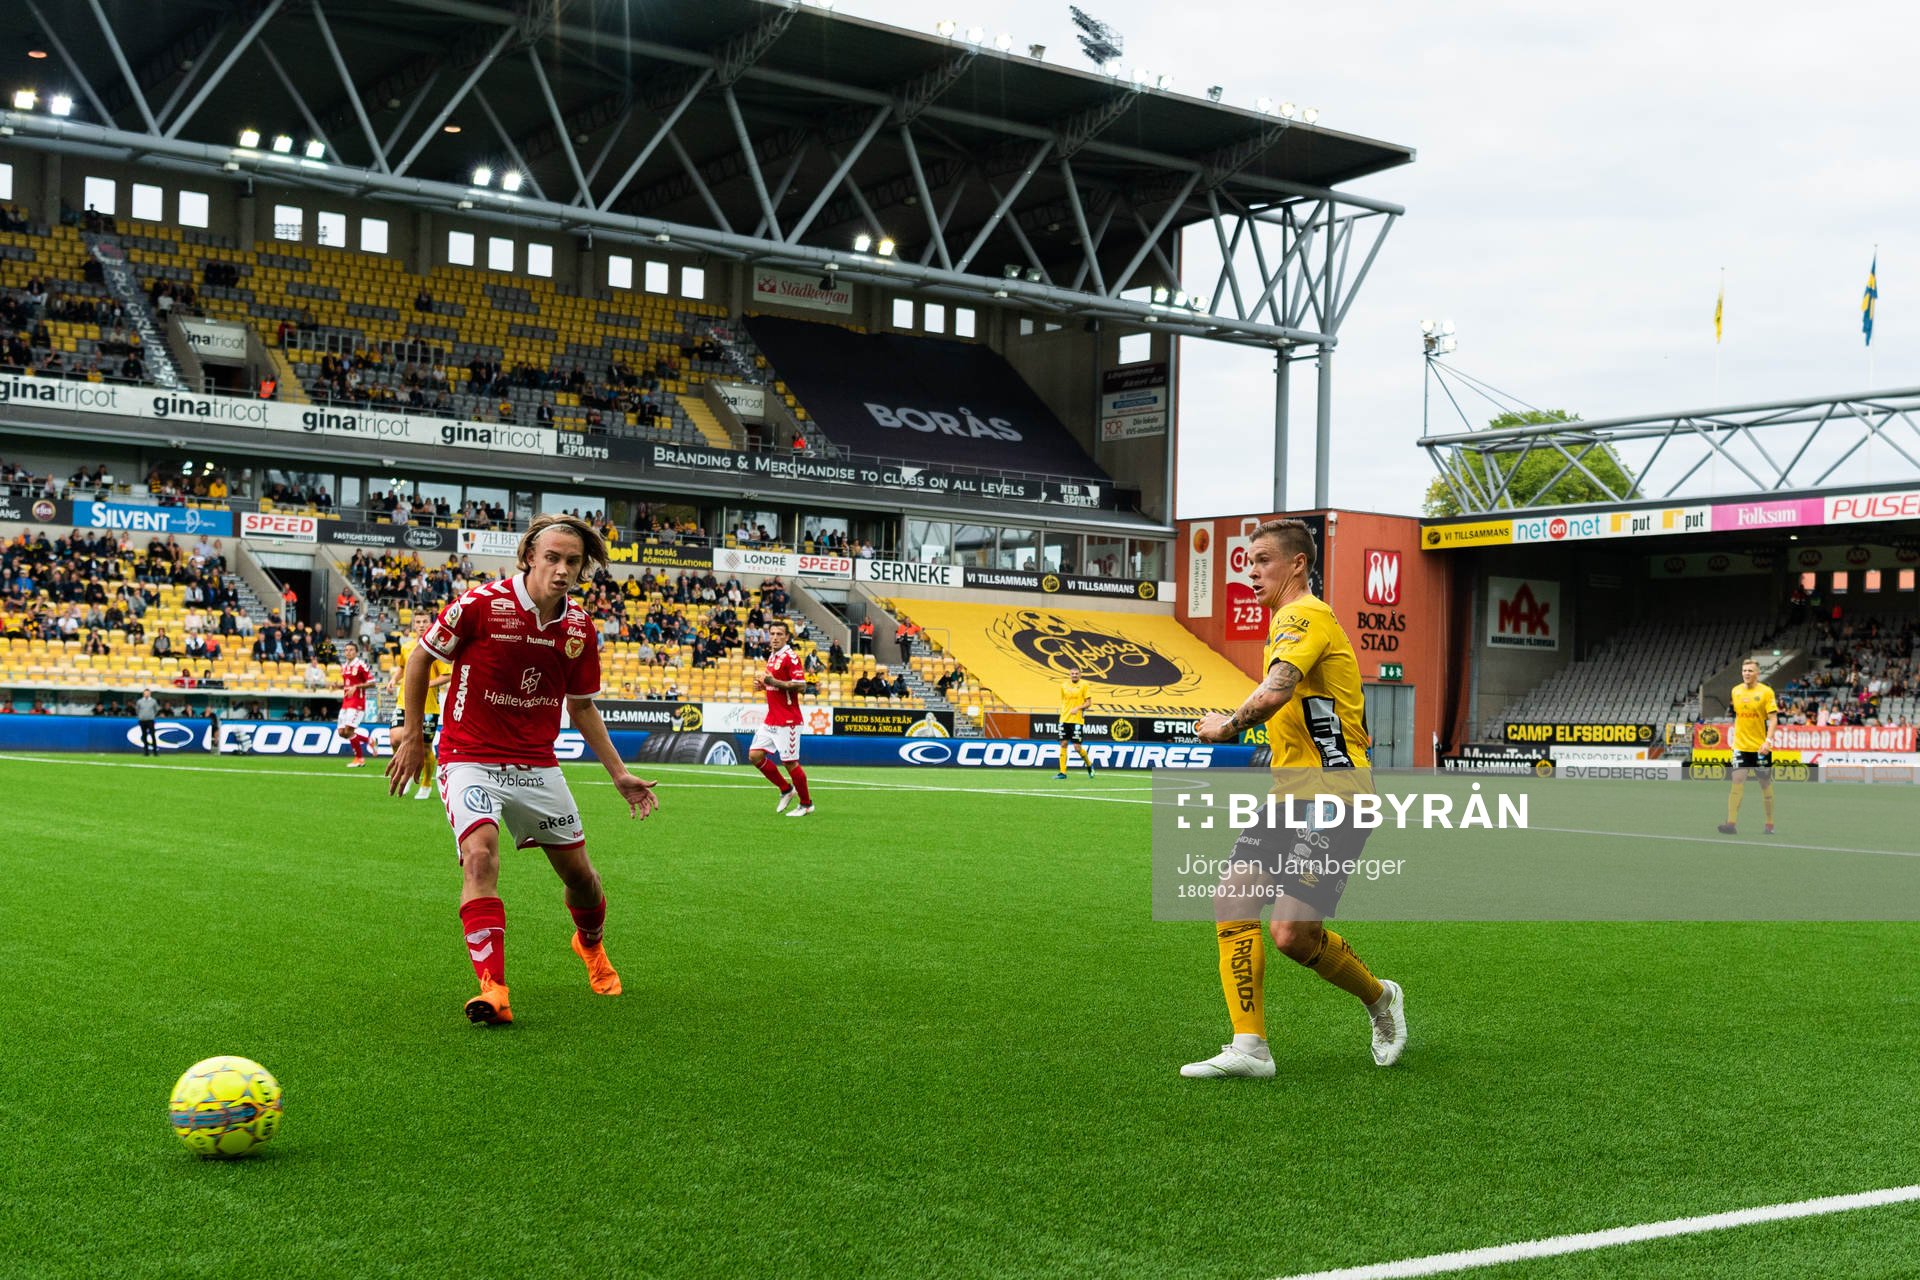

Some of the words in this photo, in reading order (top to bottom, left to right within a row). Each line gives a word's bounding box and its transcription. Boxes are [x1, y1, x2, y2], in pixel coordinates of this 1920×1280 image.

[864, 402, 1024, 443] BORÅS
[562, 444, 609, 459] SPORTS
[654, 447, 732, 468] BRANDING
[737, 455, 749, 470] &
[860, 470, 878, 482] TO
[883, 472, 927, 488] CLUBS
[929, 478, 948, 489] ON
[953, 479, 976, 492] ALL
[981, 482, 1025, 497] LEVELS
[1831, 494, 1920, 520] PULSE
[91, 502, 170, 531] SILVENT
[246, 515, 314, 533] SPEED
[1737, 506, 1797, 527] Folksam
[1444, 532, 1452, 540] VI
[1454, 527, 1510, 539] TILLSAMMANS
[744, 554, 787, 567] LONDRÉ
[799, 556, 850, 571] SPEED
[870, 561, 950, 584] SERNEKE
[967, 573, 976, 582] VI
[977, 573, 1038, 587] TILLSAMMANS
[1067, 580, 1076, 590] VI
[1077, 581, 1135, 594] TILLSAMMANS
[1233, 607, 1263, 624] 7-23
[1498, 581, 1550, 636] MAX
[1357, 609, 1407, 632] BORÅS
[527, 635, 556, 647] hummel
[1360, 633, 1399, 652] STAD
[452, 664, 471, 722] SCANIA
[600, 710, 671, 723] LLSAMMANS
[834, 715, 849, 723] OST
[851, 715, 869, 723] MED
[870, 716, 891, 724] SMAK
[892, 714, 912, 724] FRÅN
[844, 724, 876, 732] SVENSKA
[878, 723, 903, 733] ÄNGAR
[1034, 723, 1043, 733] VI
[1153, 720, 1201, 734] STRI
[1507, 725, 1553, 741] CAMP
[1555, 725, 1637, 742] ELFSBORG
[1173, 736, 1202, 744] TRAVE
[1836, 727, 1865, 749] rött
[1871, 726, 1911, 750] kort!
[1444, 759, 1455, 771] VI
[1456, 759, 1532, 775] TILLSAMMANS
[1565, 766, 1669, 780] SVEDBERGS
[1694, 766, 1723, 779] EAB
[1774, 766, 1806, 781] EAB
[488, 771, 545, 787] Nybloms
[538, 814, 575, 830] akea
